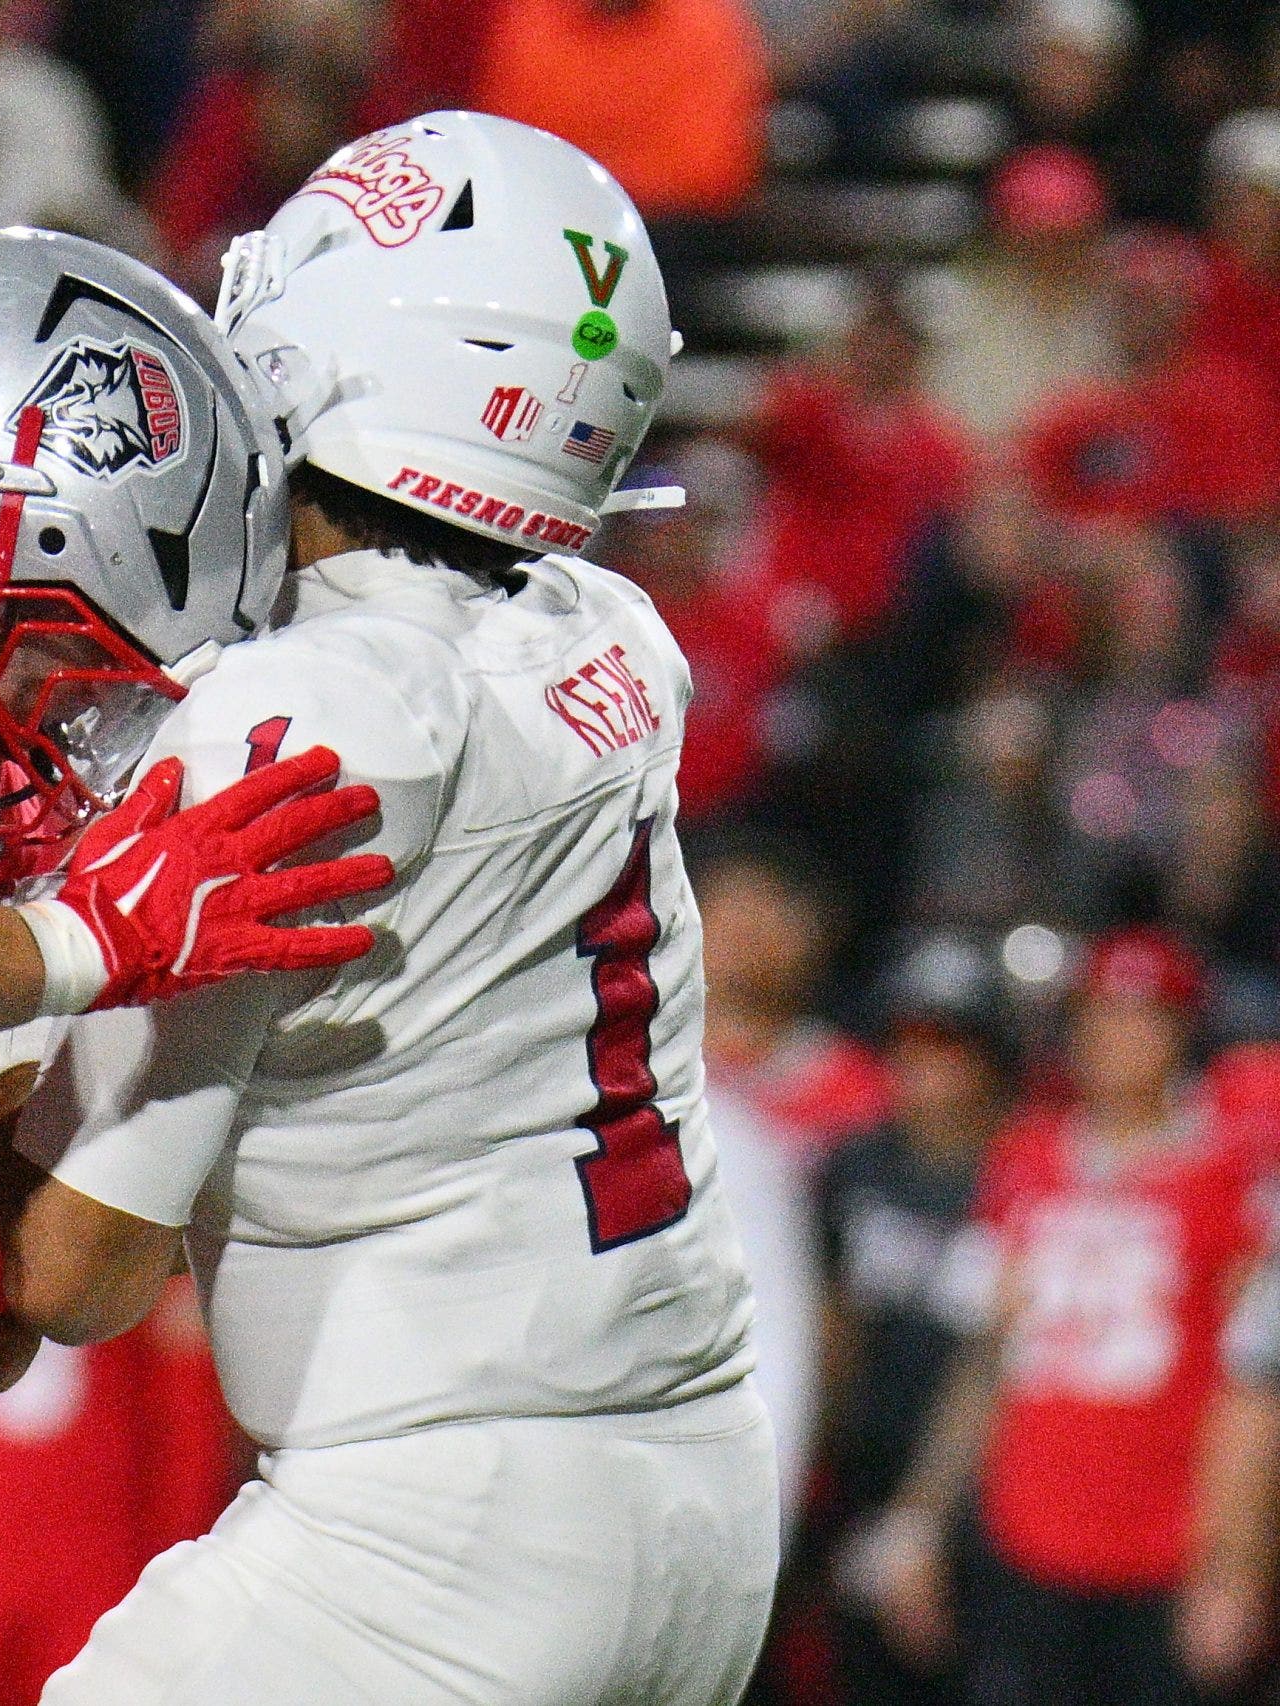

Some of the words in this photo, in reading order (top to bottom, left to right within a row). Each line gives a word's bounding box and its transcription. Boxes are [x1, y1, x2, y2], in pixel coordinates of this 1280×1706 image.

[563, 230, 630, 309] V
[131, 346, 179, 462] LOBOS
[387, 466, 525, 532] FRESNO
[545, 644, 661, 759] KEENE
[573, 814, 693, 1256] 1
